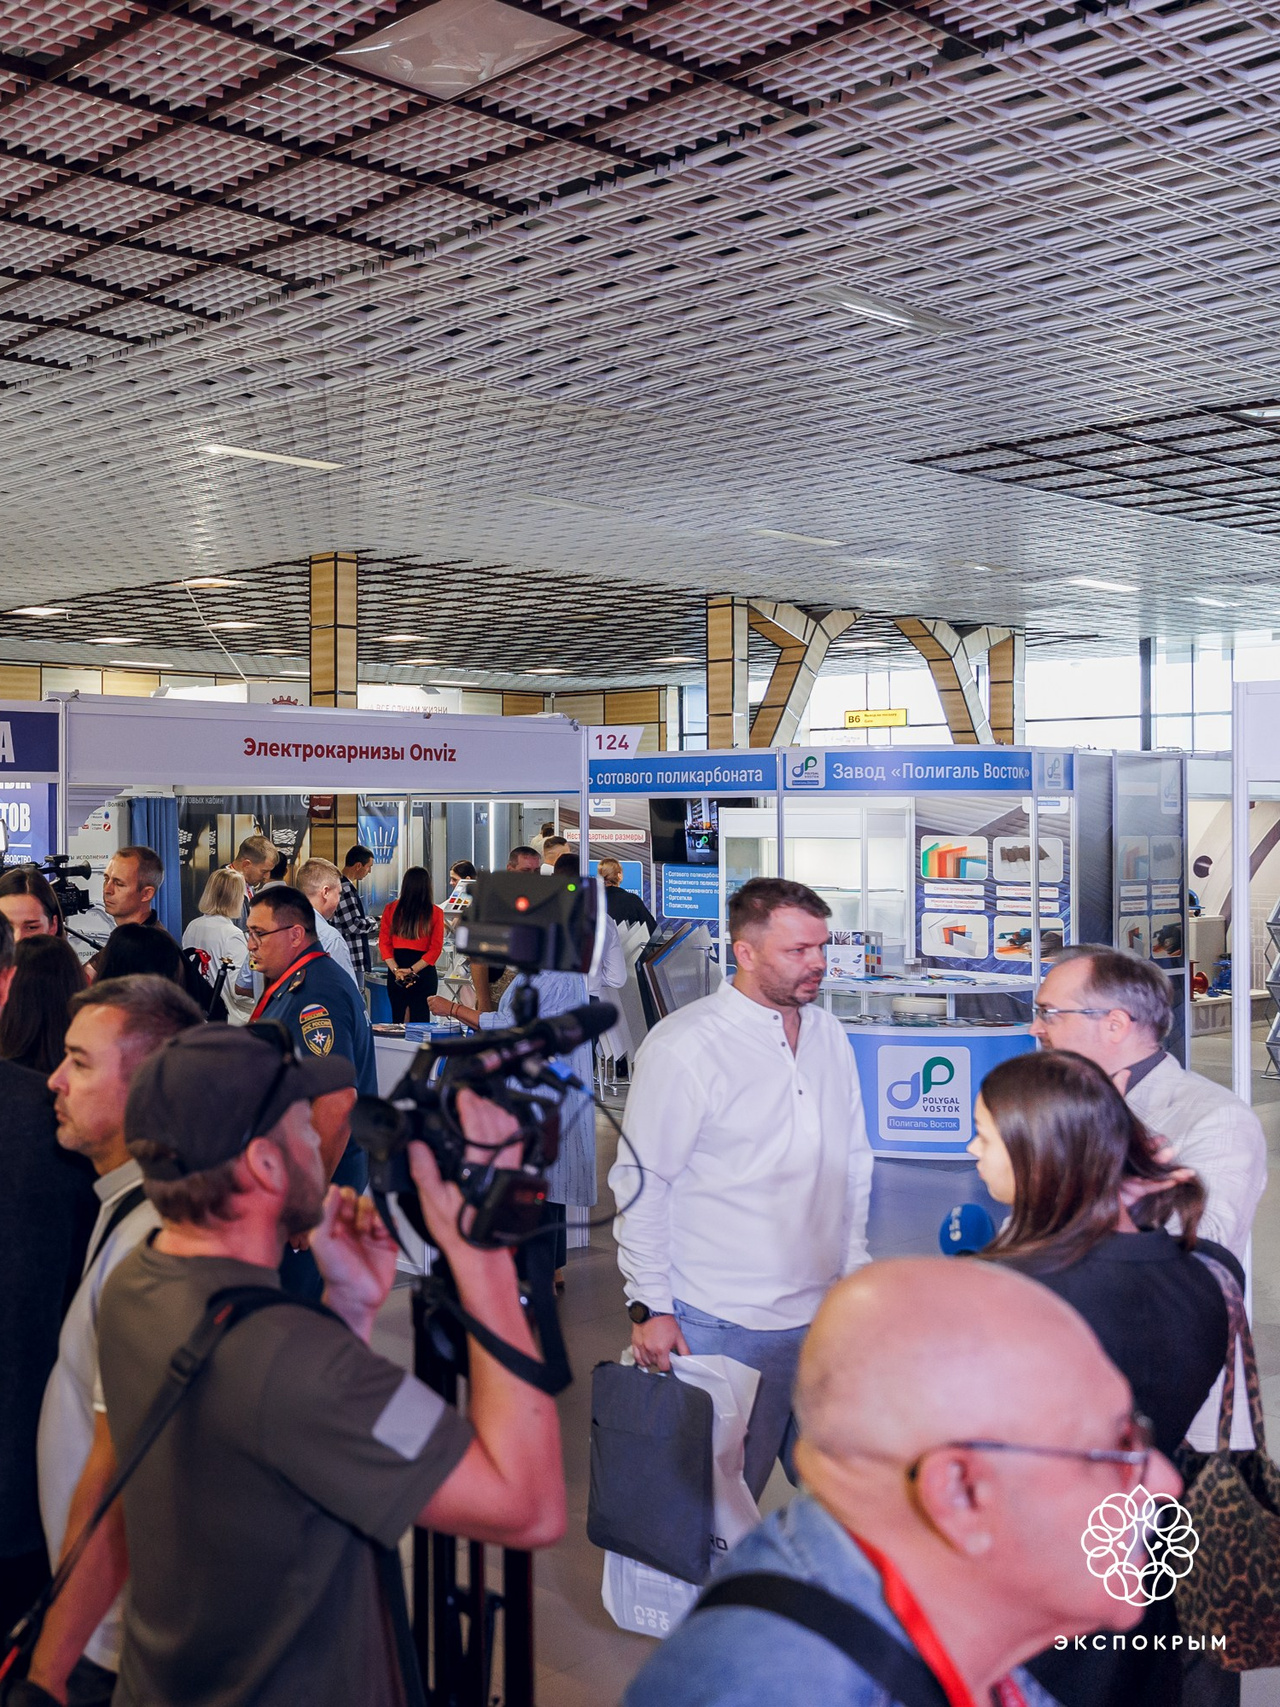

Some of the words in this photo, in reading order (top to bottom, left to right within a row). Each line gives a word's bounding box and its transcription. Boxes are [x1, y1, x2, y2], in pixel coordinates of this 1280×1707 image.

[422, 706, 448, 714] ЖИЗНИ
[848, 715, 861, 723] B6
[595, 734, 629, 750] 124
[243, 737, 404, 765] Электрокарнизы
[409, 742, 457, 762] Onviz
[596, 771, 653, 785] сотового
[656, 766, 763, 786] поликарбоната
[832, 762, 886, 781] Завод
[891, 762, 979, 780] «Полигаль
[984, 763, 1030, 780] Восток»
[922, 1097, 960, 1105] POLYGAL
[922, 1105, 960, 1113] VOSTOK
[889, 1118, 928, 1128] Полигаль
[930, 1120, 957, 1129] Восток
